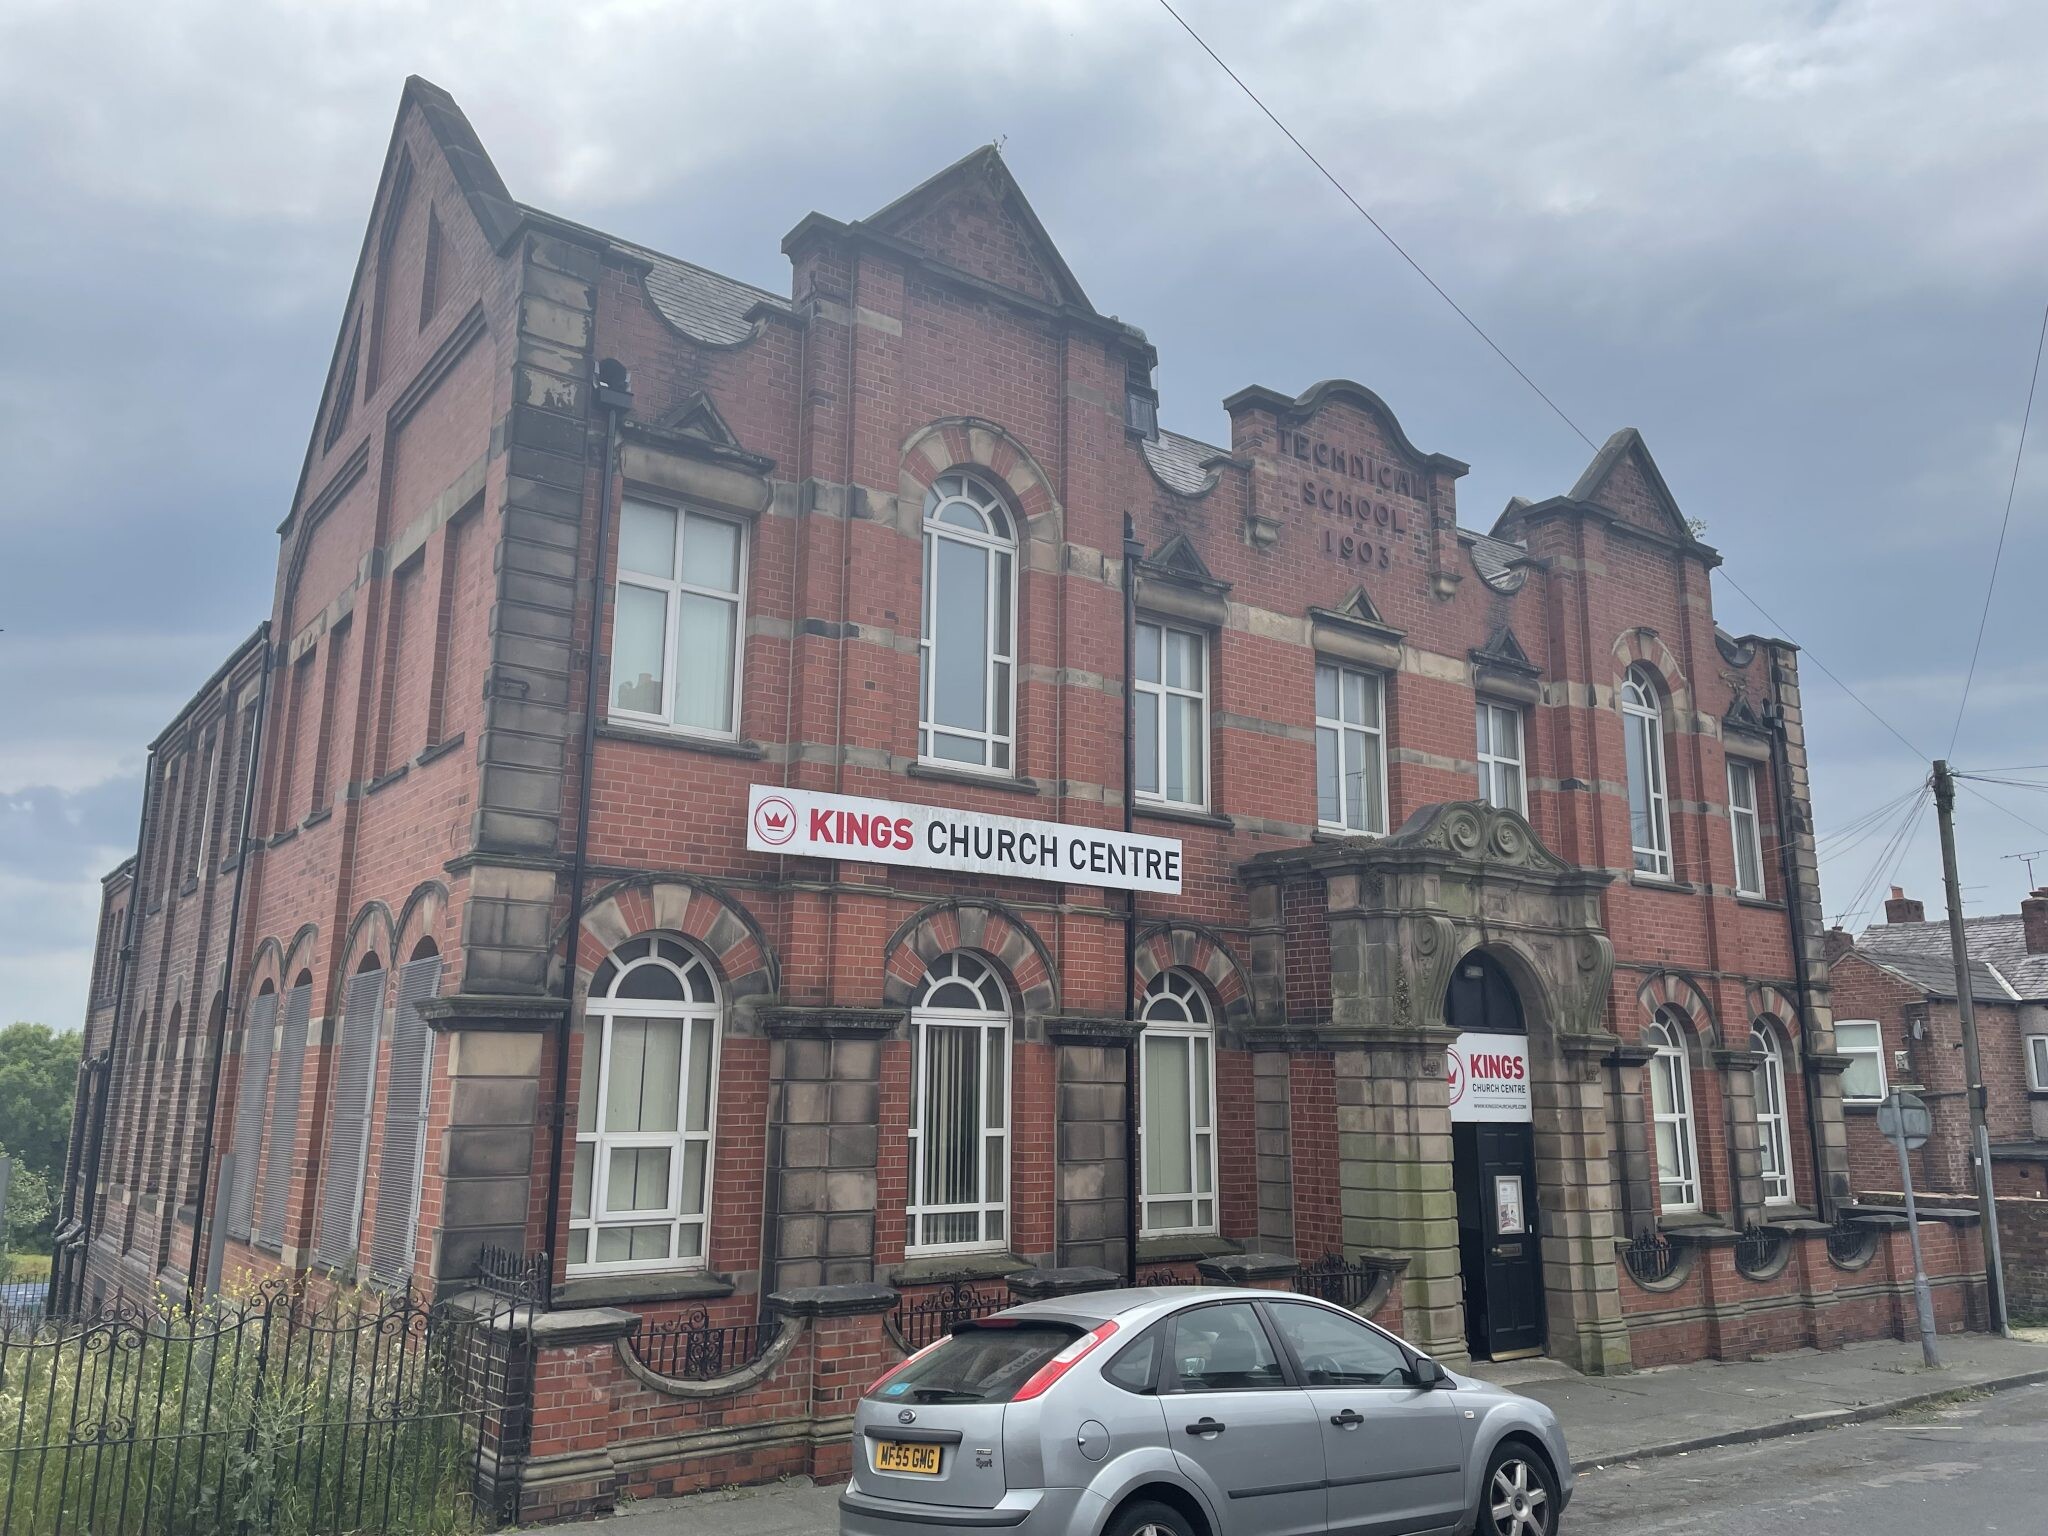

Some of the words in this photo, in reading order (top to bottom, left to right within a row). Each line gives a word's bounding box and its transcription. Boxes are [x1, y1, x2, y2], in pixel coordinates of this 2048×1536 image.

[1280, 430, 1427, 503] TECHNICAL
[1303, 481, 1405, 534] SCHOOL
[1326, 530, 1389, 568] 1903
[809, 808, 914, 851] KINGS
[929, 820, 1058, 868] CHURCH
[1069, 838, 1180, 882] CENTRE
[1470, 1053, 1525, 1080] KINGS
[1472, 1083, 1500, 1093] CHURCH
[1501, 1084, 1526, 1094] CENTRE
[880, 1445, 909, 1467] MF55
[912, 1448, 935, 1470] GMG
[976, 1457, 993, 1469] Sport
